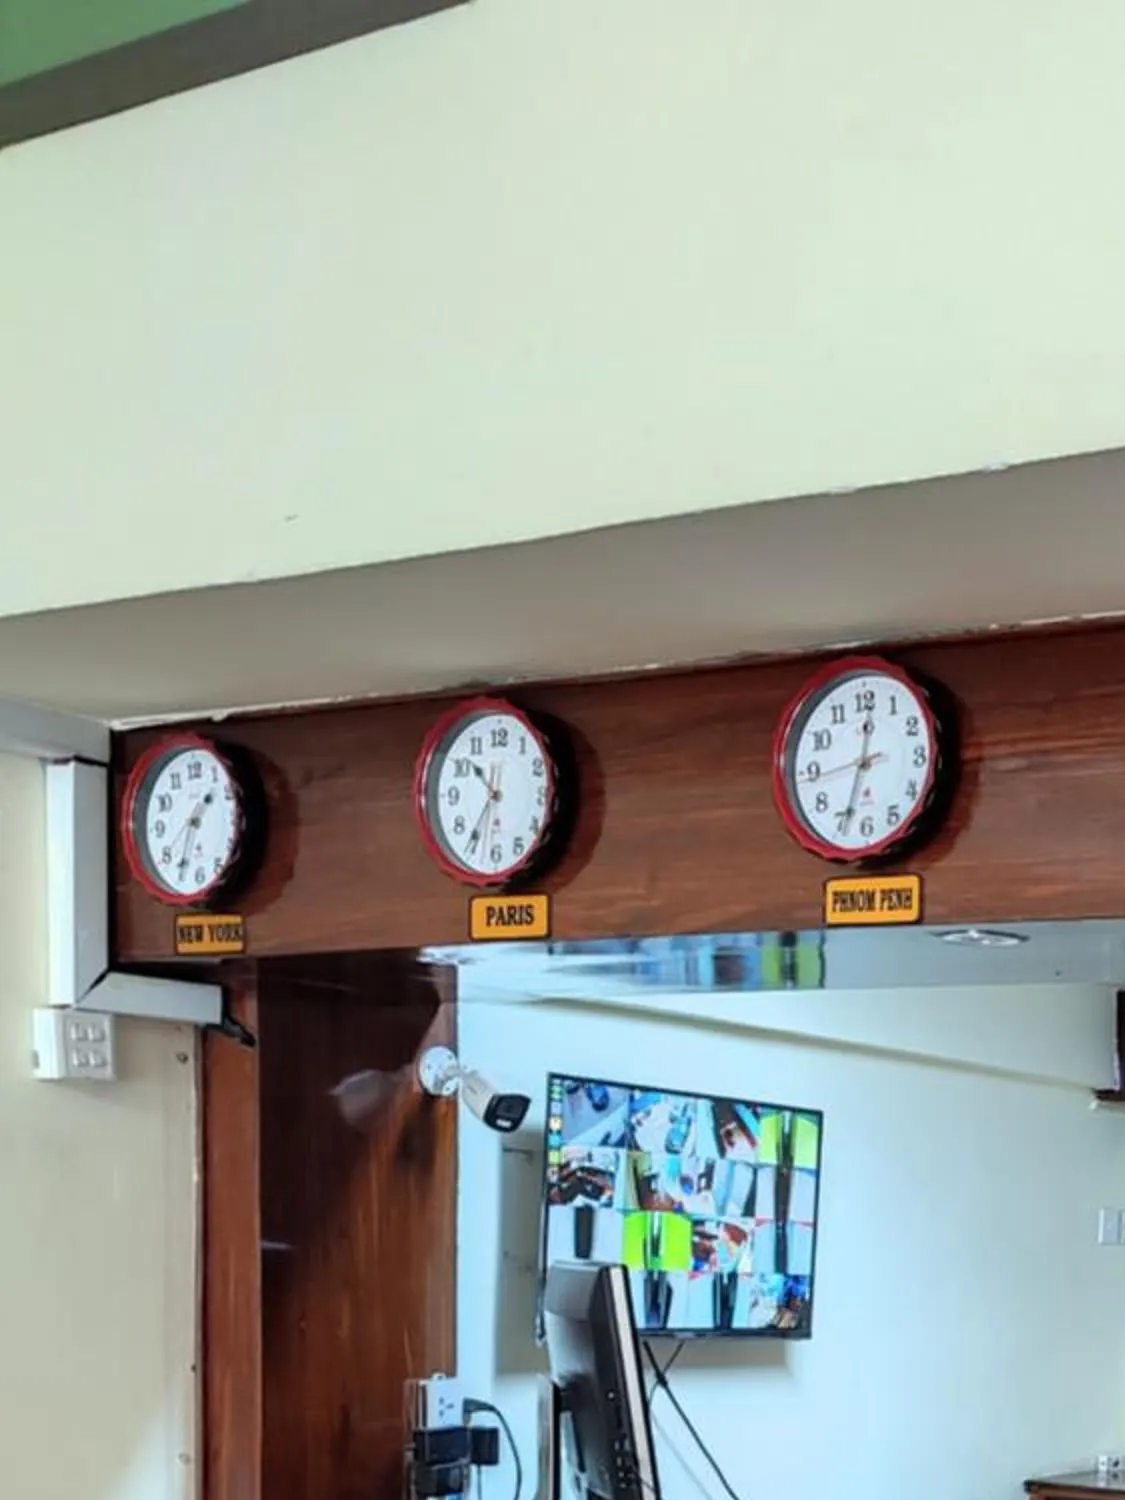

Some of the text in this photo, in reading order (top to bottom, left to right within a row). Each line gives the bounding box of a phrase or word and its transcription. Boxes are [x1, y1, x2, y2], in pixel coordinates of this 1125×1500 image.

[855, 691, 876, 712] 12
[831, 704, 846, 724] 11
[906, 717, 918, 736] 2
[470, 737, 483, 755] 11
[490, 727, 508, 747] 12
[813, 729, 831, 750] 10
[914, 746, 926, 767] 3
[454, 759, 470, 777] 10
[532, 759, 543, 775] 2
[807, 762, 820, 781] 9
[448, 787, 459, 805] 9
[906, 780, 917, 800] 4
[816, 793, 828, 812] 8
[454, 816, 465, 834] 8
[887, 805, 899, 826] 5
[860, 817, 873, 836] 6
[491, 845, 502, 863] 6
[513, 838, 523, 855] 5
[486, 905, 534, 926] PARIS
[177, 924, 241, 944] NEW YORK
